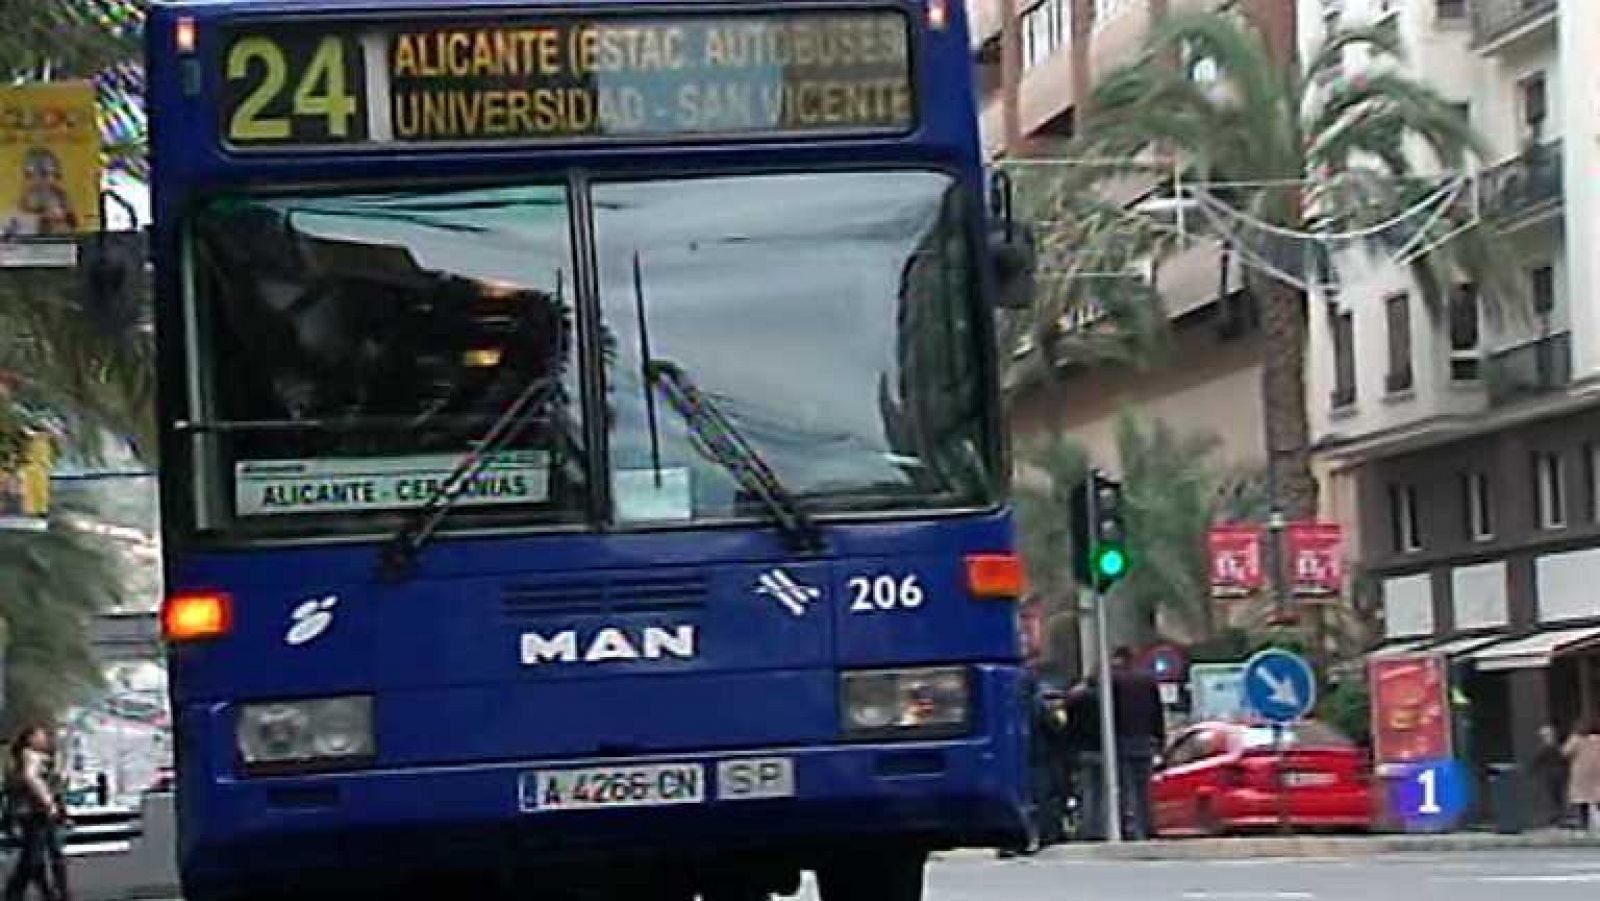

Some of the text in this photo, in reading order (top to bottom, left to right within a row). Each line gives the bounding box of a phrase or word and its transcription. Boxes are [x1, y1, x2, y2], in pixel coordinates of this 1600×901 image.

[395, 30, 561, 76] ALICANTE
[228, 35, 356, 139] 24
[396, 86, 644, 135] UNIVERSIDAD
[679, 84, 754, 126] SAN
[766, 78, 911, 125] VICENTE
[263, 481, 375, 506] ALICANTE
[395, 475, 528, 502] CERANIAS
[849, 575, 924, 611] 206
[520, 625, 694, 664] MAN
[731, 764, 782, 793] SP
